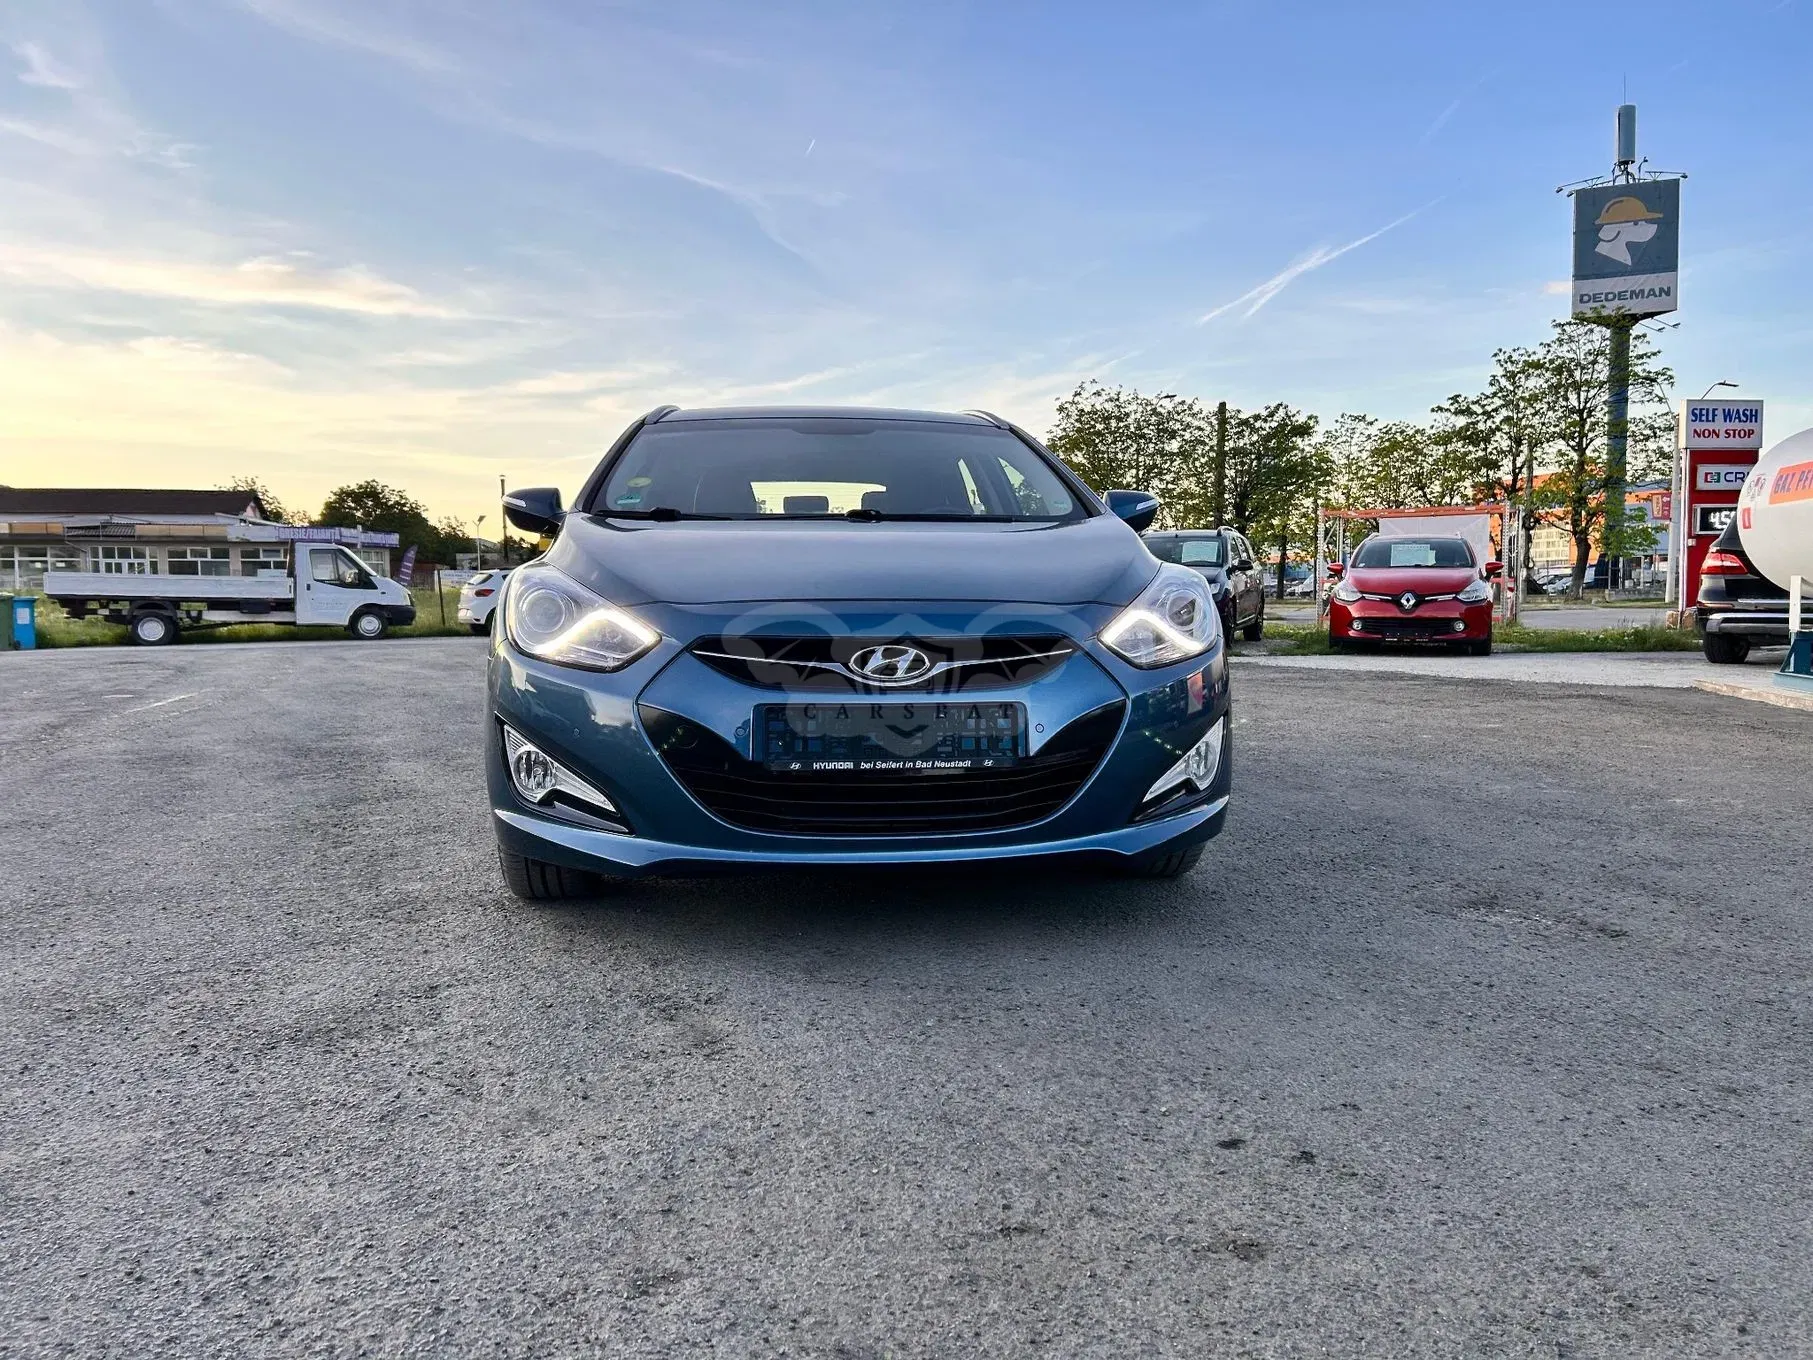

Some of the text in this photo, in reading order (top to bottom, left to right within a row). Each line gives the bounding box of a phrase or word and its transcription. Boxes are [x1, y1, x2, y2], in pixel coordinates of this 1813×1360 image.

[1579, 286, 1671, 304] DEDEMAN
[1691, 407, 1758, 423] SELF WASH
[1693, 428, 1754, 439] NON STOP
[1724, 471, 1750, 483] CR
[1774, 471, 1796, 495] GAZ
[813, 762, 854, 770] HYUNDAI
[860, 761, 874, 769] bei
[876, 761, 904, 769] Seifert
[915, 760, 932, 768] Bad
[934, 760, 972, 768] Neustadt
